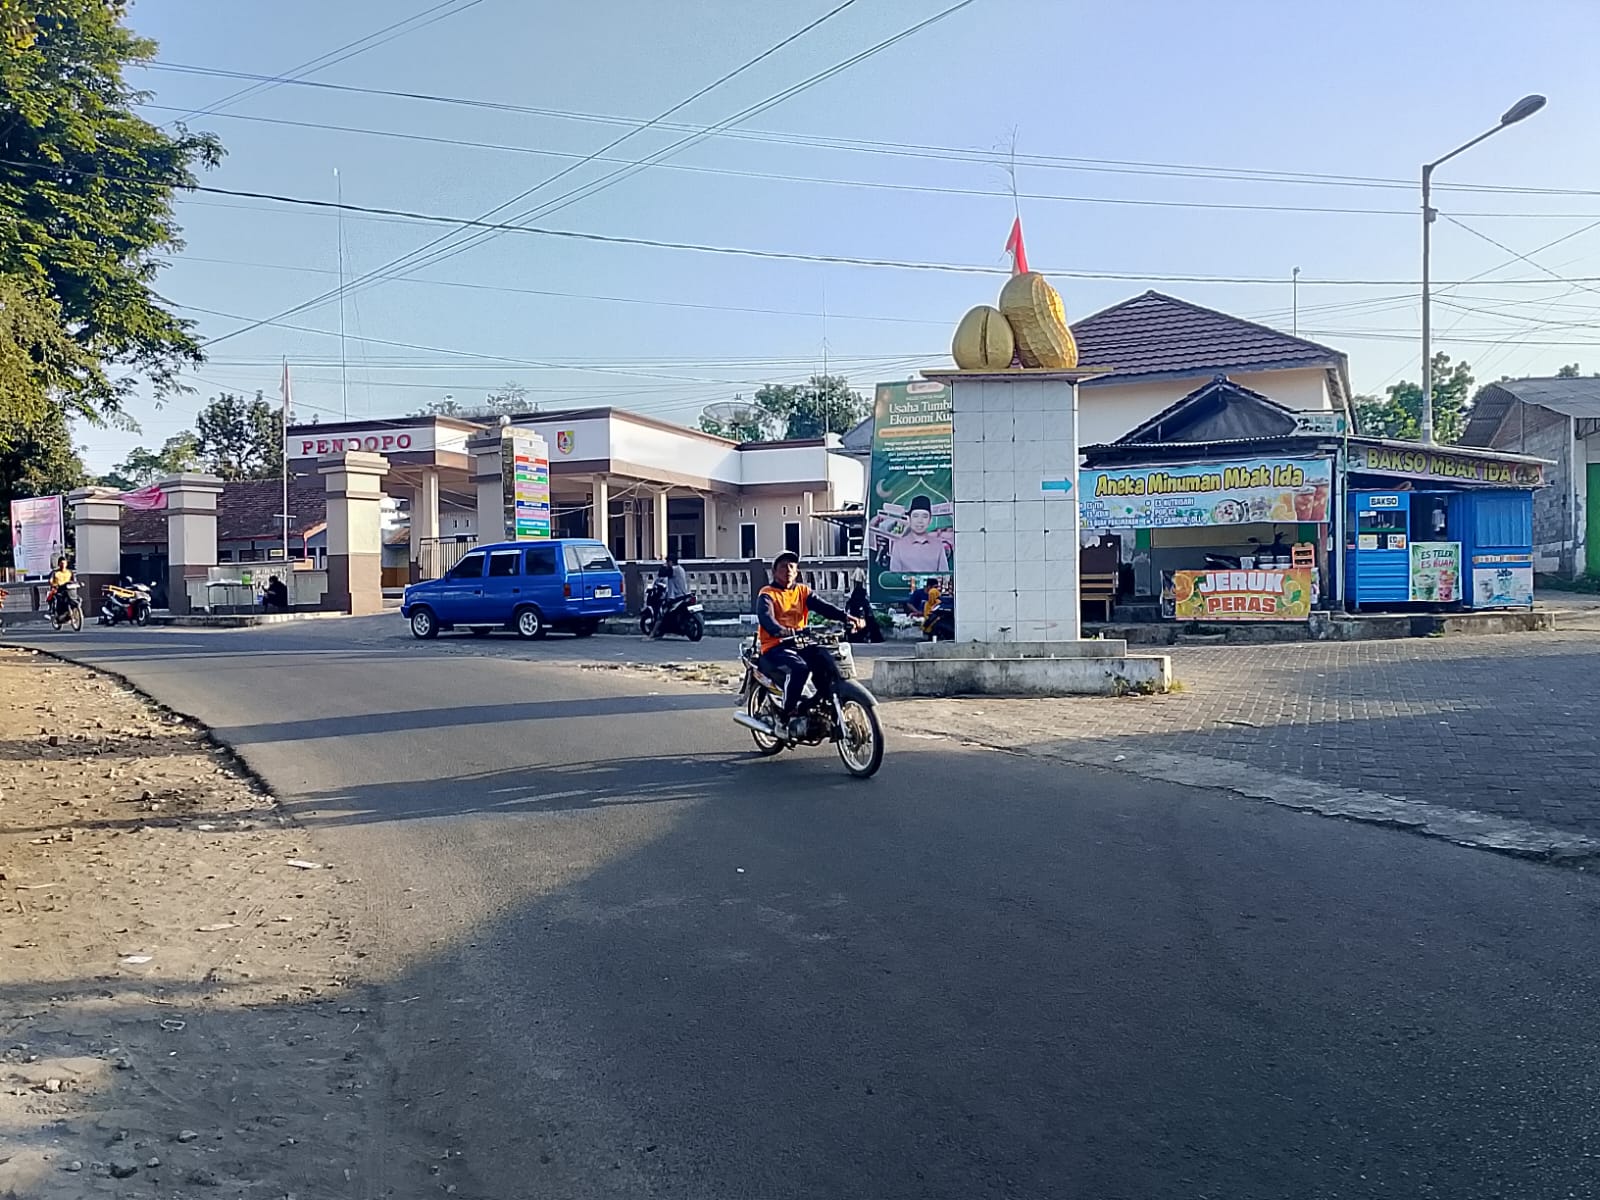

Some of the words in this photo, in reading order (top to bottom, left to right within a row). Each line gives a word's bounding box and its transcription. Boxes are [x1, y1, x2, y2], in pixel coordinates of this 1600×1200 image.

[889, 402, 919, 414] Usaha
[890, 413, 934, 425] Ekonomi
[302, 434, 411, 455] PENDOPO
[1367, 448, 1427, 473] BAKSO
[1429, 454, 1479, 480] MBAK
[1483, 462, 1511, 482] IDA
[1095, 475, 1145, 497] Aneka
[1147, 472, 1222, 495] Minuman
[1224, 465, 1271, 490] Mbak
[1273, 464, 1304, 487] Ida
[1371, 498, 1397, 506] BAKSO
[1421, 551, 1431, 560] ES
[1421, 560, 1431, 569] ES
[1199, 572, 1284, 593] JERUK
[1207, 596, 1277, 614] PERAS
